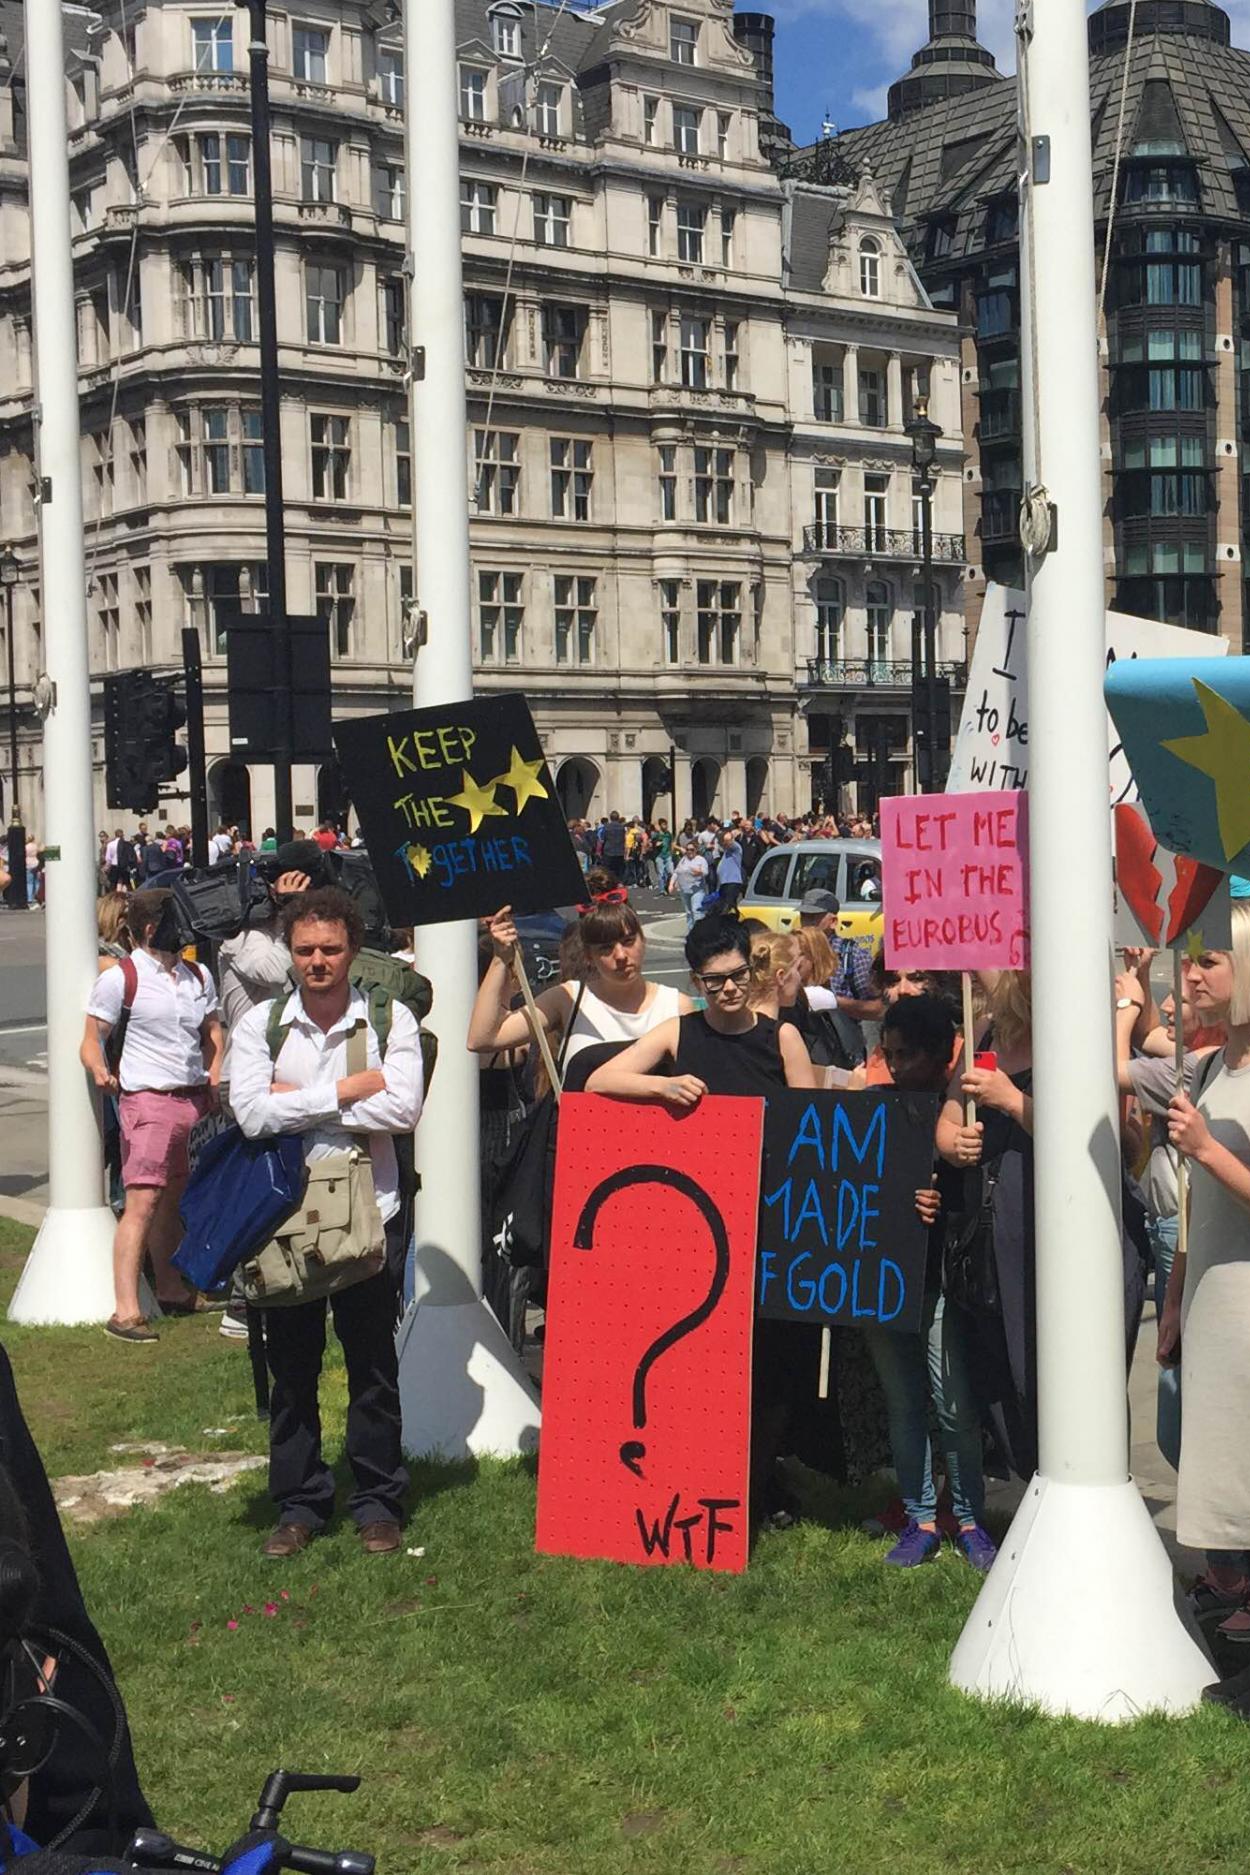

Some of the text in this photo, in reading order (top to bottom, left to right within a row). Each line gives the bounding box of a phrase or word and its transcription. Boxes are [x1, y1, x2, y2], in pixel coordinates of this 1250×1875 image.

[992, 608, 1027, 681] I
[976, 689, 999, 734] to
[387, 726, 478, 778] KEEP
[393, 793, 455, 828] THE
[895, 809, 1016, 851] LET ME
[904, 864, 1015, 905] IN THE
[893, 910, 1003, 951] EUROBUS
[787, 1103, 887, 1178] AM
[760, 1250, 906, 1322] F GOLD
[635, 1492, 741, 1564] WTF
